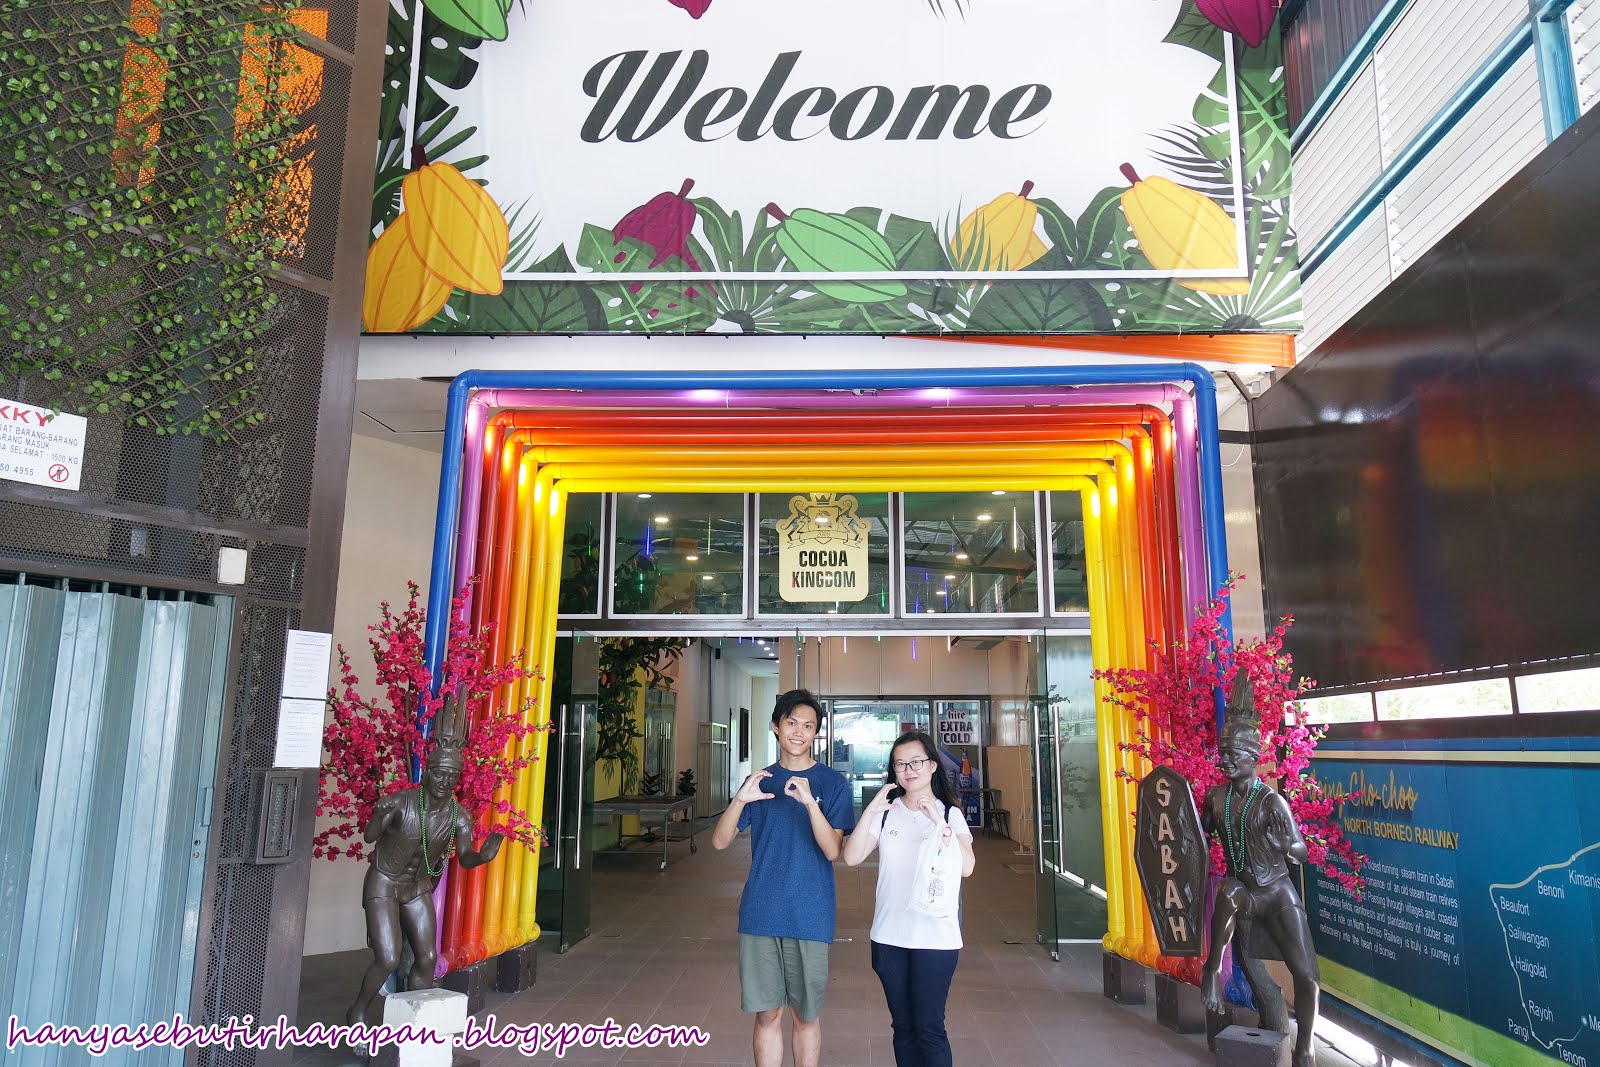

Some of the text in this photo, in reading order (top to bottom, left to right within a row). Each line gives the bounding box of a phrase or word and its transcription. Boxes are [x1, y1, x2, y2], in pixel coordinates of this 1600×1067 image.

[580, 49, 1052, 143] Welcome
[0, 433, 50, 449] RANG MASUK
[16, 427, 78, 447] BARANG-BARANG
[10, 445, 44, 458] SELAMAT
[52, 453, 65, 462] 1500
[68, 456, 79, 465] KG
[14, 465, 34, 477] 4955
[799, 550, 848, 567] COCOA
[792, 570, 856, 588] KINGDOM
[940, 721, 973, 732] EXTRA
[1344, 817, 1459, 850] NORTH BORNEO RAILWAY
[1155, 778, 1187, 942] SABAH
[1401, 867, 1416, 880] steam
[1416, 869, 1428, 884] train
[1429, 872, 1435, 884] in
[1435, 873, 1454, 889] Sabah
[1387, 880, 1392, 891] of
[1394, 883, 1400, 894] an
[1400, 883, 1408, 896] old
[1409, 886, 1425, 900] steam
[1425, 890, 1438, 903] train
[1438, 893, 1458, 908] relives
[1537, 880, 1565, 899] Benoni
[1368, 890, 1385, 909] Passing
[1385, 896, 1405, 913] through
[1405, 901, 1424, 918] villages
[1425, 909, 1435, 921] and
[1437, 913, 1458, 928] coastal
[1500, 896, 1530, 917] Beaufort
[1376, 912, 1386, 923] and
[1387, 914, 1413, 932] plantations
[1415, 922, 1421, 934] of
[1423, 926, 1440, 940] rubber
[1443, 933, 1455, 945] and
[1508, 923, 1550, 949] Saliwangan
[1366, 922, 1382, 938] Borneo
[1384, 928, 1402, 948] Railway
[1405, 936, 1410, 948] is
[1410, 938, 1421, 955] truly
[1430, 945, 1450, 965] journey
[1454, 954, 1459, 965] of
[1515, 956, 1548, 979] Haligolat
[1528, 1000, 1554, 1022] Rayoh
[1508, 1018, 1530, 1042] Pangi
[1557, 1043, 1587, 1067] Tenom
